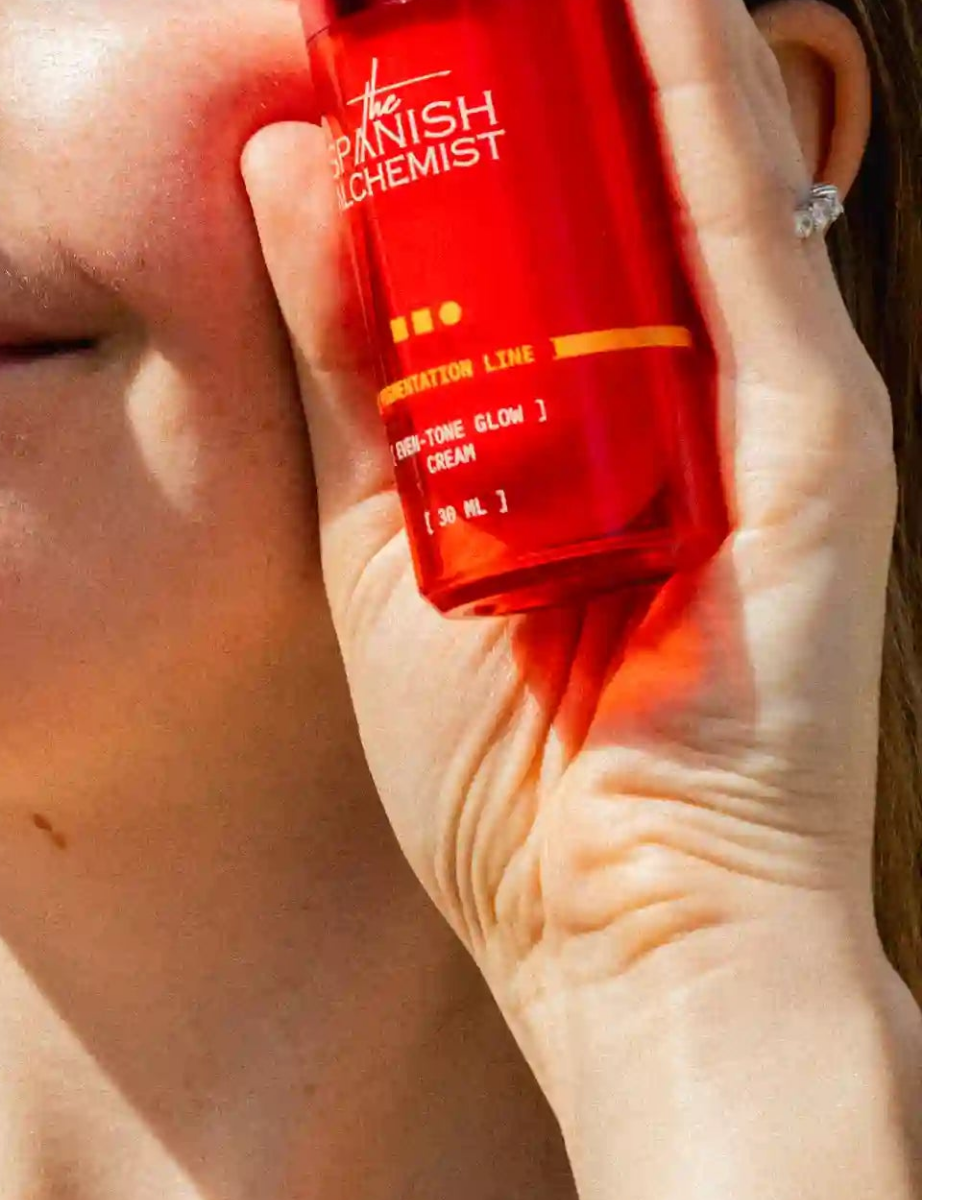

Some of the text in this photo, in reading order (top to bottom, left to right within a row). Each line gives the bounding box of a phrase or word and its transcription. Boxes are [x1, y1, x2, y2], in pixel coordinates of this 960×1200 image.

[347, 58, 451, 163] the
[484, 345, 535, 373] LINE
[474, 405, 524, 434] GLOW
[426, 443, 477, 474] CREAM
[438, 507, 457, 528] 30
[464, 497, 488, 518] ML
